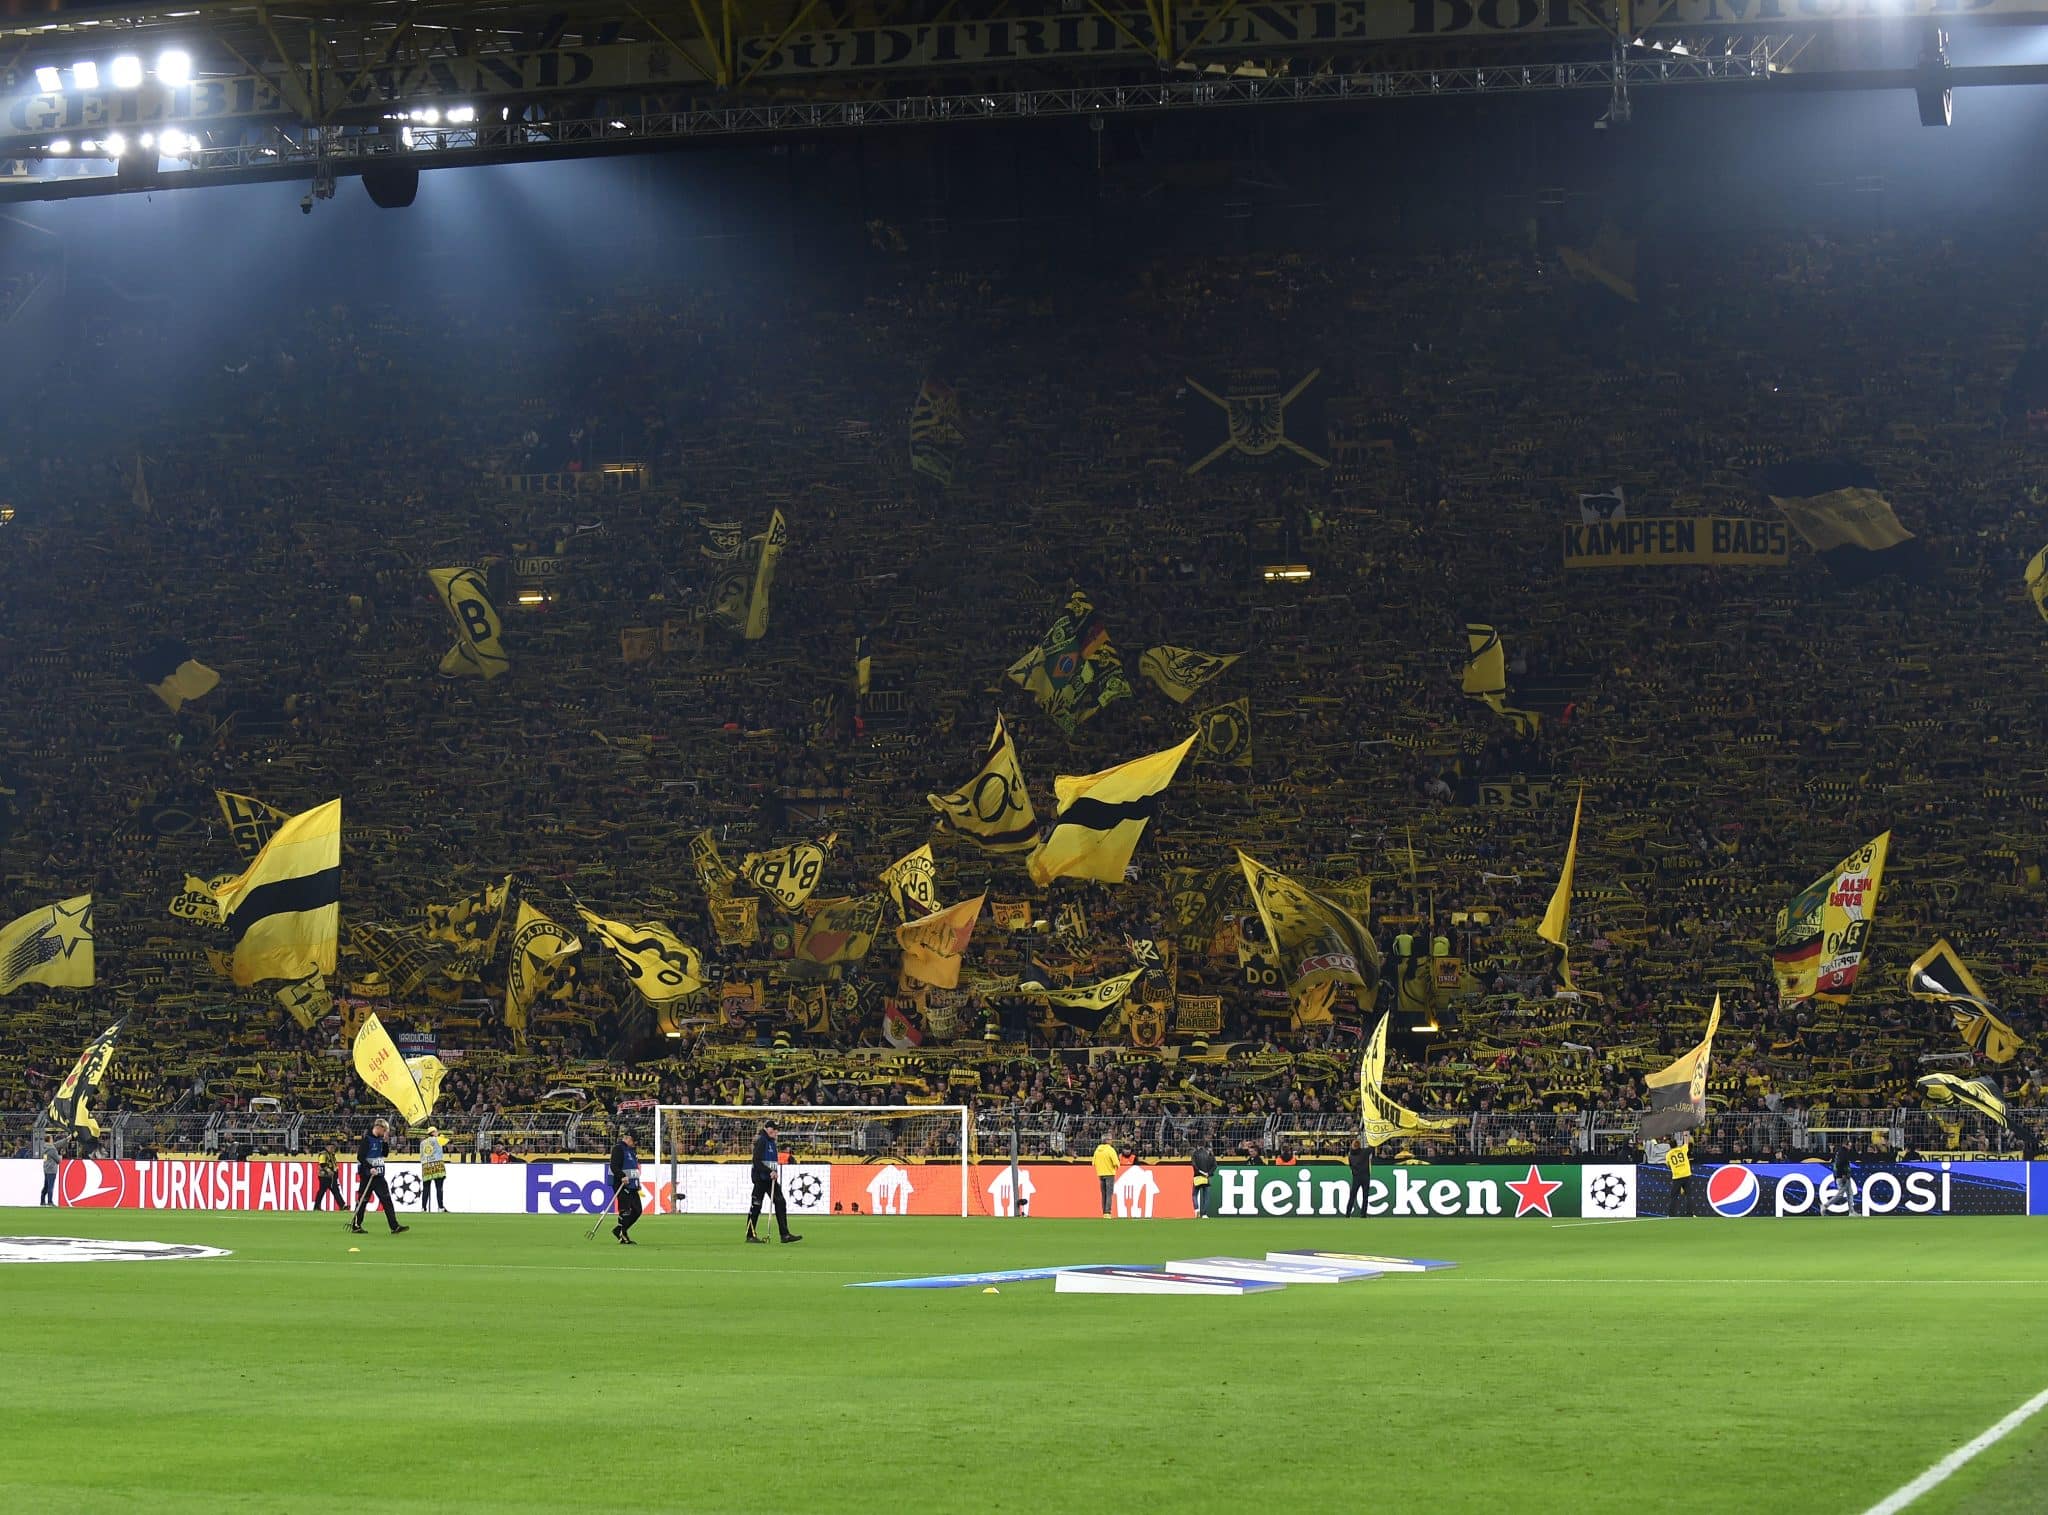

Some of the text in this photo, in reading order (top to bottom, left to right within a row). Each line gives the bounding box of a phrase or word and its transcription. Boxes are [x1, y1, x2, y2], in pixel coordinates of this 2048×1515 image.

[10, 79, 283, 129] GELBE
[335, 52, 593, 101] WAND
[1671, 1152, 1685, 1166] 09
[135, 1161, 384, 1212] TURKISH AIRLNE
[525, 1163, 673, 1214] Fedx
[1218, 1168, 1502, 1216] Heineken
[1776, 1162, 1951, 1217] pepsi
